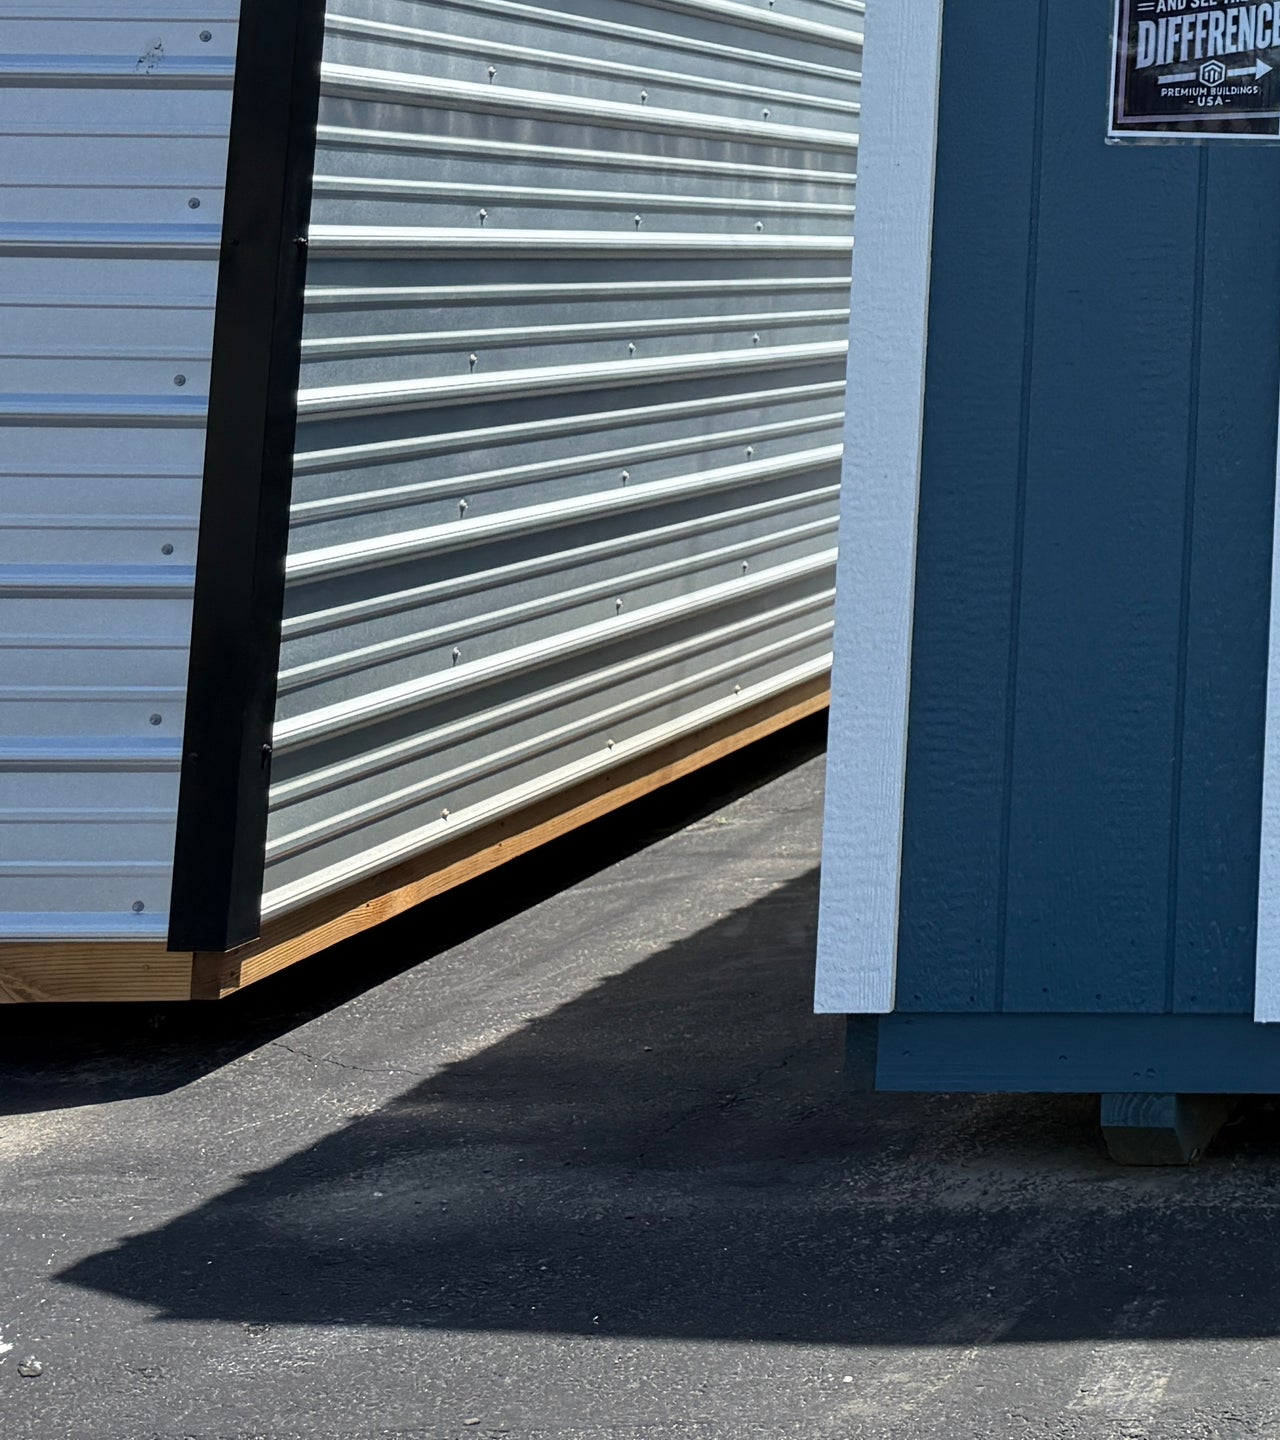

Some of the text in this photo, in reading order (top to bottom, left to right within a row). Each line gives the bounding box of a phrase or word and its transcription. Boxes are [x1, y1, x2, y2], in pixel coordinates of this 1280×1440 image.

[1161, 86, 1259, 97] PREMIUM BUILDINGS
[1197, 96, 1223, 106] USA
